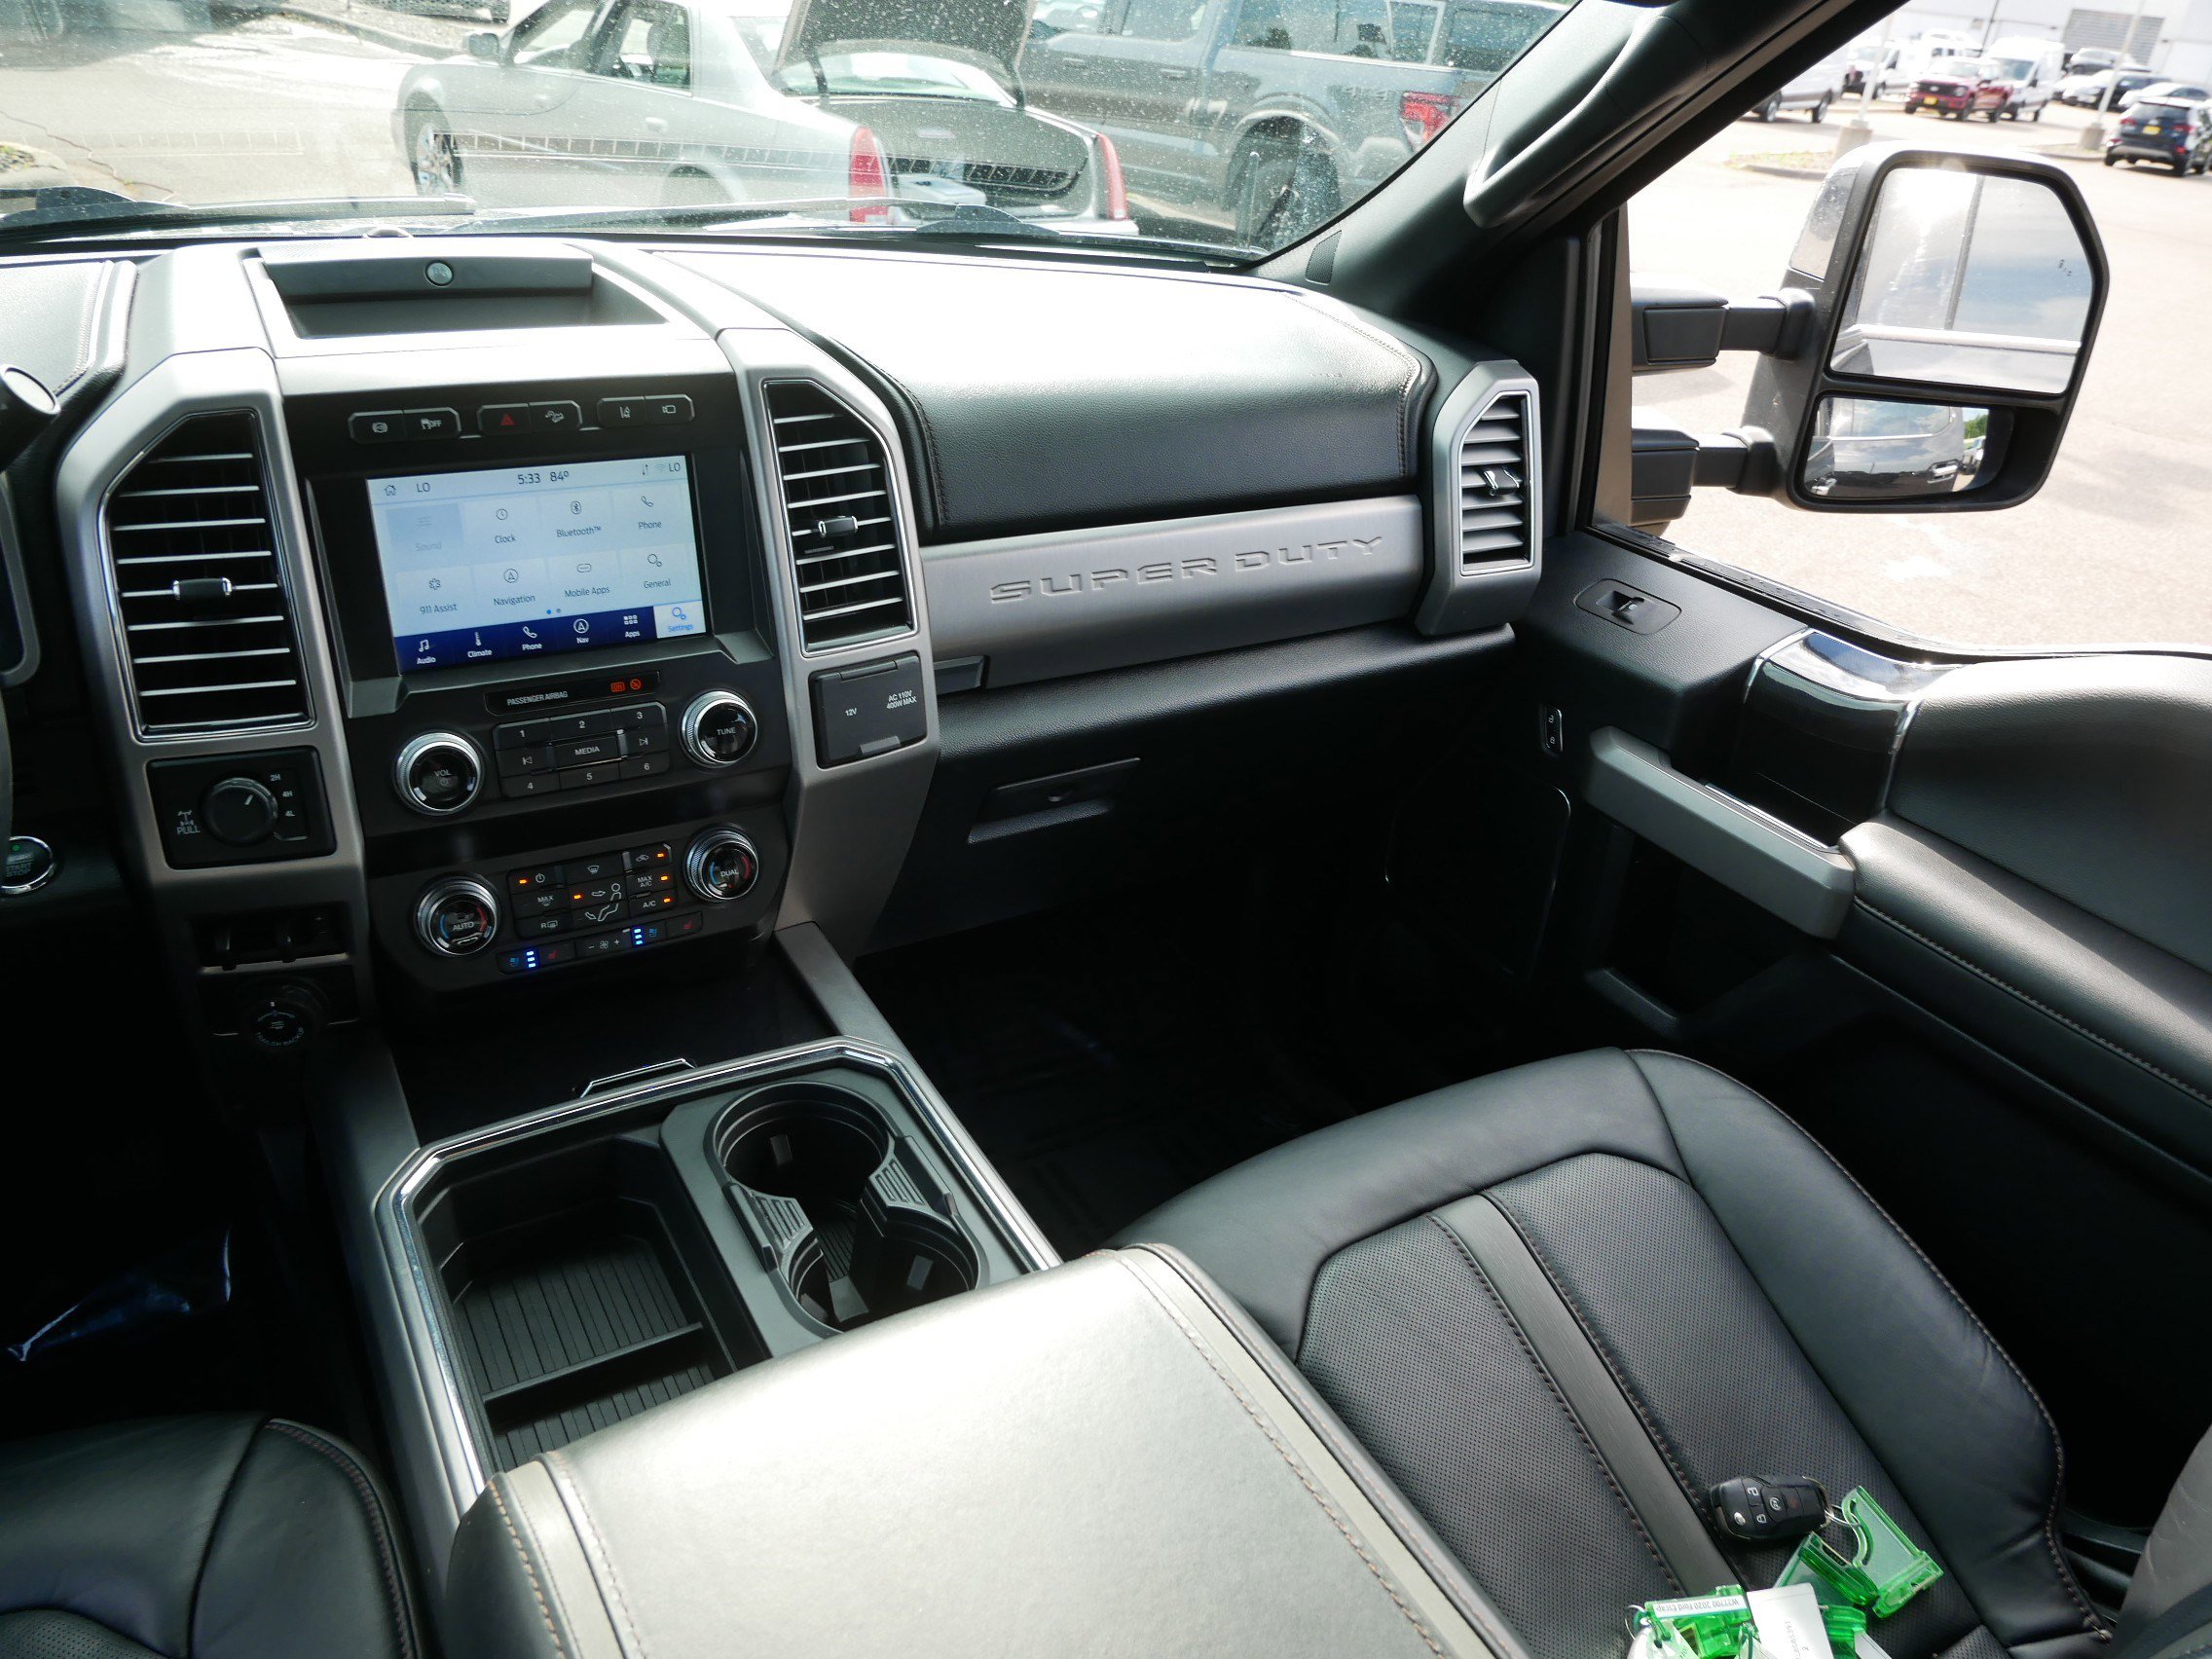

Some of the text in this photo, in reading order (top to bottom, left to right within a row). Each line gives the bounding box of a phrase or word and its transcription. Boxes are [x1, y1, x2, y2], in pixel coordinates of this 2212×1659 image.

[668, 461, 682, 473] LO
[517, 473, 541, 485] 5:33
[416, 482, 431, 494] LO
[638, 520, 662, 531] Phone
[495, 535, 516, 544] Clock
[990, 535, 1382, 604] SUPER DUTY
[644, 578, 672, 589] General
[565, 586, 610, 598] Mobile Apps
[493, 594, 535, 607] Navigation
[419, 603, 458, 615] 911 Assist
[668, 623, 694, 633] Settings
[625, 630, 641, 639] Apps
[576, 636, 589, 645] Nav
[522, 641, 542, 651] Phone
[467, 646, 493, 658] Climate
[417, 653, 436, 664] Audio
[507, 690, 569, 706] PASSENGER AIRBAG
[888, 690, 912, 702] AC 110V
[903, 695, 917, 706] MAX
[636, 711, 644, 719] 3
[844, 707, 857, 717] 12V
[578, 720, 586, 729] 2
[519, 729, 526, 738] 1
[717, 726, 736, 736] TUNE
[574, 746, 601, 756] MEDIA
[644, 762, 650, 771] 6
[433, 768, 453, 777] VOL
[586, 772, 593, 781] 5
[527, 782, 534, 791] 4
[176, 825, 201, 835] PULL
[720, 868, 739, 877] DUAL
[638, 875, 653, 884] MAX
[537, 895, 554, 903] MAX
[643, 900, 657, 908] A/C
[452, 921, 475, 932] AUTO
